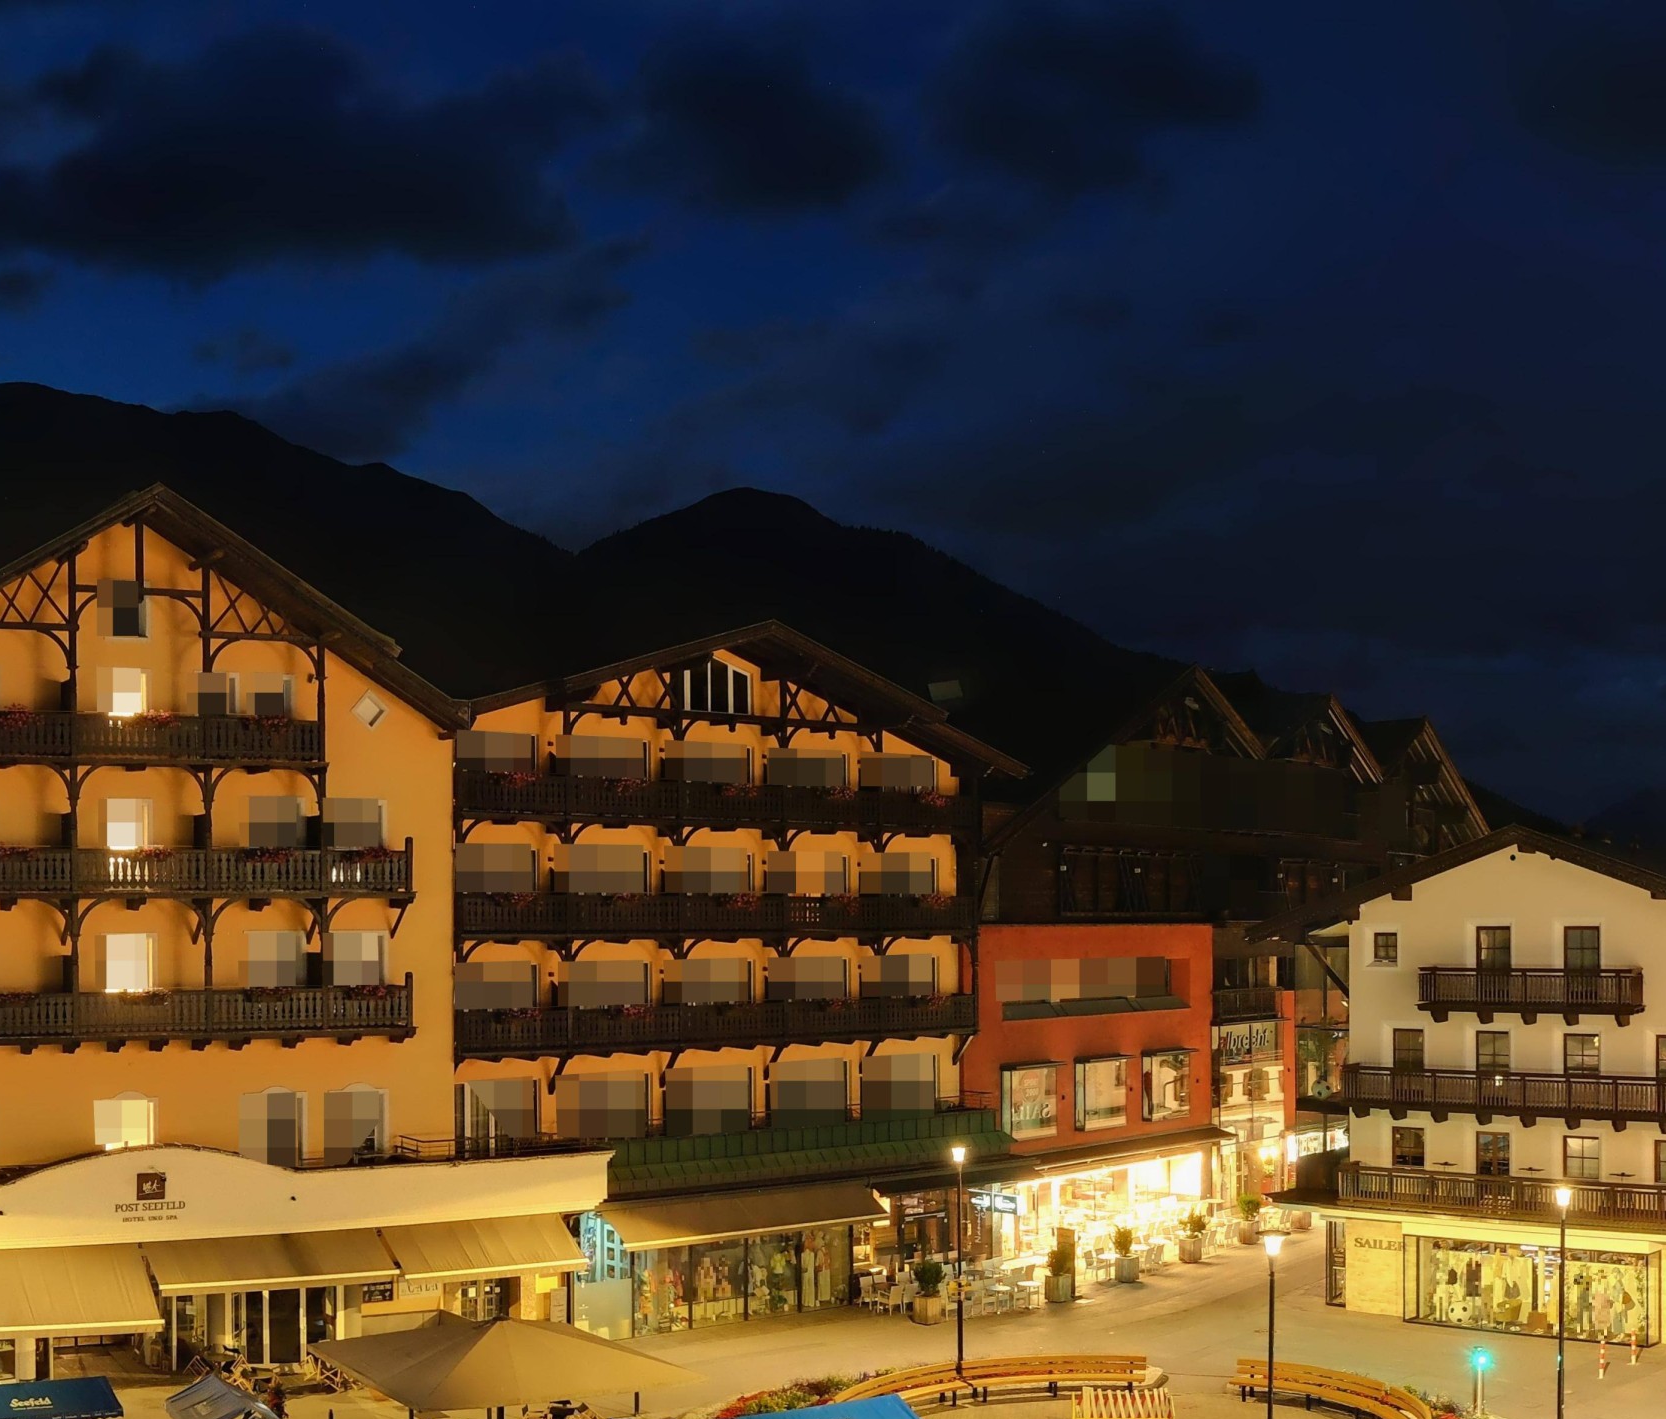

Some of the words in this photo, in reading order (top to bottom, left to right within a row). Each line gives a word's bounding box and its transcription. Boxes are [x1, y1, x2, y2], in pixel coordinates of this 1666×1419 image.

[115, 1203, 140, 1213] POST
[142, 1200, 186, 1211] SEEFELD
[9, 1396, 53, 1409] Seefeld
